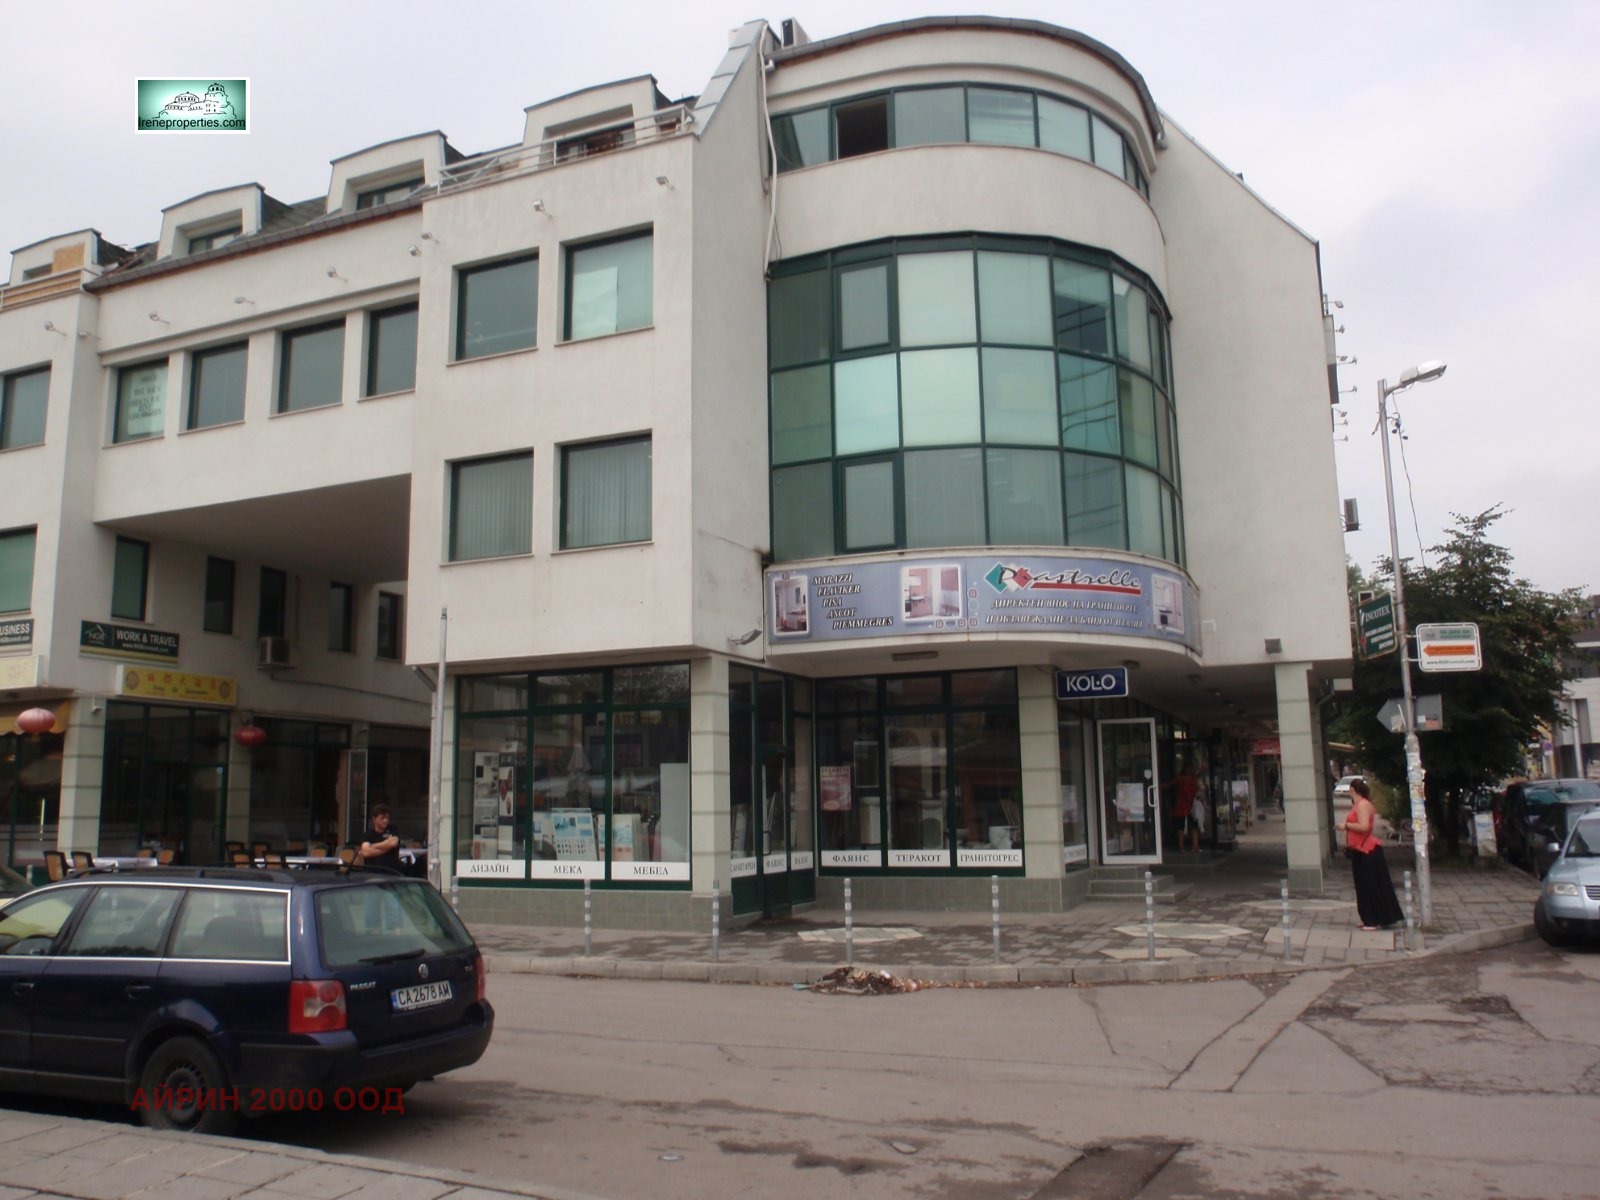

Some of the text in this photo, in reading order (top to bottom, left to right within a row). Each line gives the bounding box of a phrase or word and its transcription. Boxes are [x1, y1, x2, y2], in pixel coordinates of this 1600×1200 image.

[812, 573, 853, 585] MARAZZI
[817, 584, 861, 597] FLAVIKER
[822, 597, 842, 608] PISA
[991, 599, 1044, 609] ДИРЕКТЕН
[1046, 599, 1070, 609] ВНОС
[1073, 600, 1086, 609] НА
[827, 607, 857, 619] ASCOT
[1365, 604, 1390, 622] INCOTEX
[832, 616, 894, 630] PIEMMEGRES
[986, 614, 994, 624] И
[995, 614, 1066, 625] ОБЗАВЕЖДАНЕ
[1068, 615, 1080, 625] ЗА
[116, 629, 177, 647] WORK & TRAVEL
[832, 853, 1019, 863] ФАЯНС ТЕРАКОТ ГРАНИТОГРЕС
[470, 863, 668, 875] ДИЗАЙН МЕКА МЕБЕЛ
[399, 989, 413, 1006] CA
[413, 984, 438, 1002] 2678
[438, 982, 450, 998] AM
